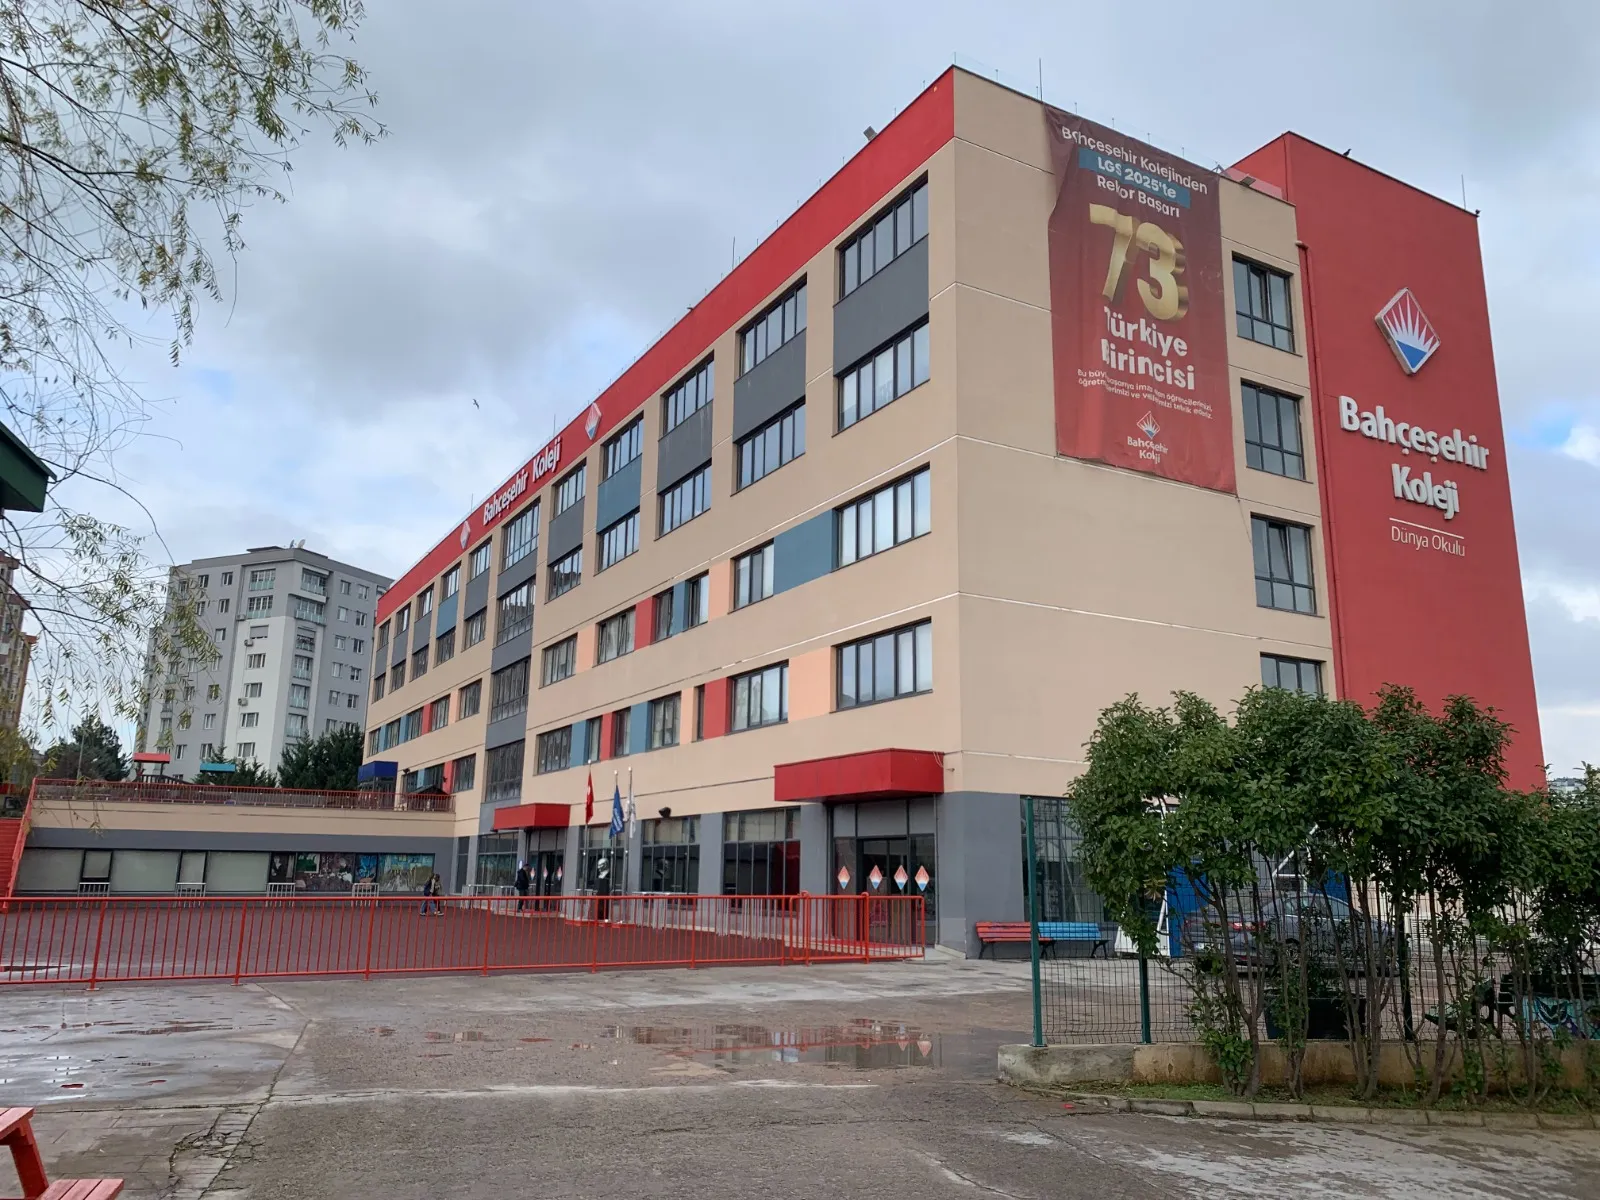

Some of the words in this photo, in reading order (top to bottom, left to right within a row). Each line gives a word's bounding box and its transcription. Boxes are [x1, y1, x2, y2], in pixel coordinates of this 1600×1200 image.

[1097, 156, 1122, 177] LGS
[1124, 168, 1177, 199] 2025'te
[1140, 156, 1208, 195] Kolejinden
[1138, 190, 1180, 218] Başarı
[1089, 203, 1189, 321] 73
[1338, 395, 1490, 470] Bahçeşehir
[1139, 449, 1161, 465] Kolji
[482, 469, 528, 526] Bahçeşehir
[532, 436, 561, 482] Koleji
[1391, 463, 1460, 520] Koleji
[1391, 525, 1429, 550] Dünya
[1431, 534, 1466, 557] Okulu
